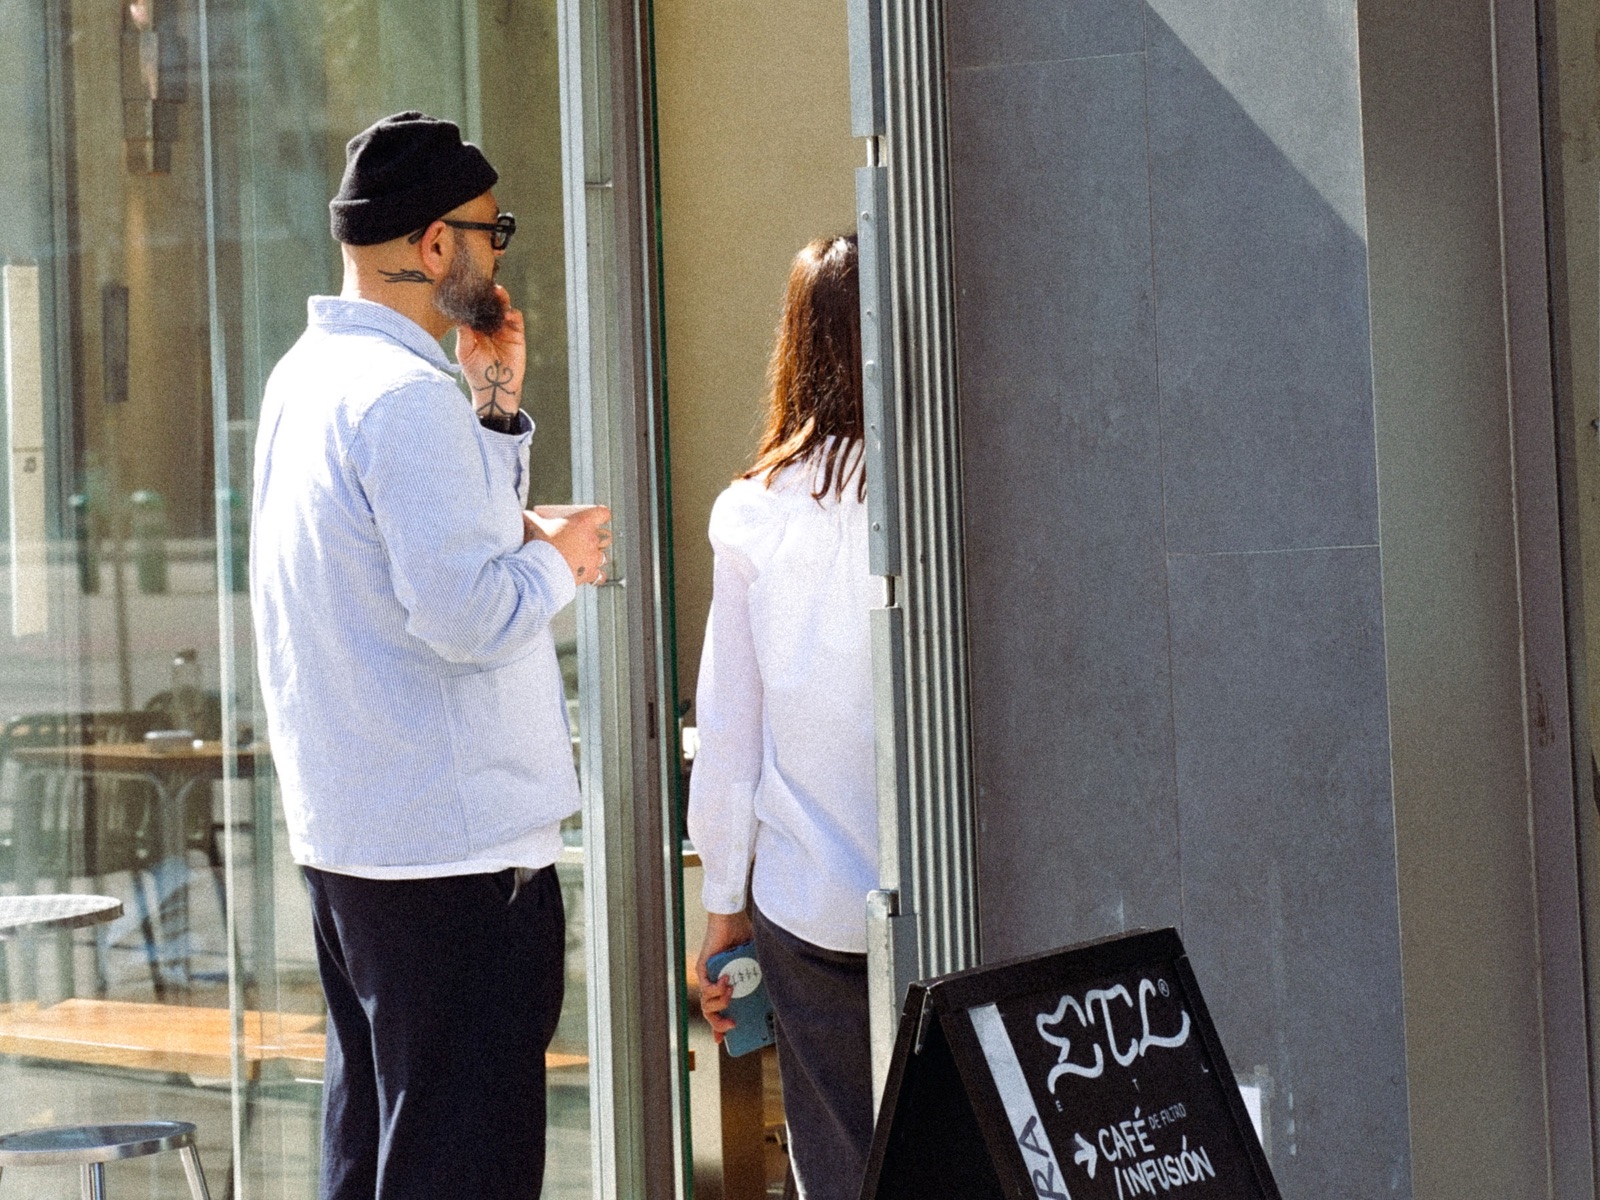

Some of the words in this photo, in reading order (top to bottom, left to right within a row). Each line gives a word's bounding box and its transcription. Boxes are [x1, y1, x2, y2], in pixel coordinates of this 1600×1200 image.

[1055, 1099, 1064, 1113] E
[1131, 1078, 1140, 1093] T
[1098, 1106, 1156, 1162] CAFÉ
[1148, 1113, 1162, 1129] DE
[1160, 1102, 1187, 1126] FILTRO
